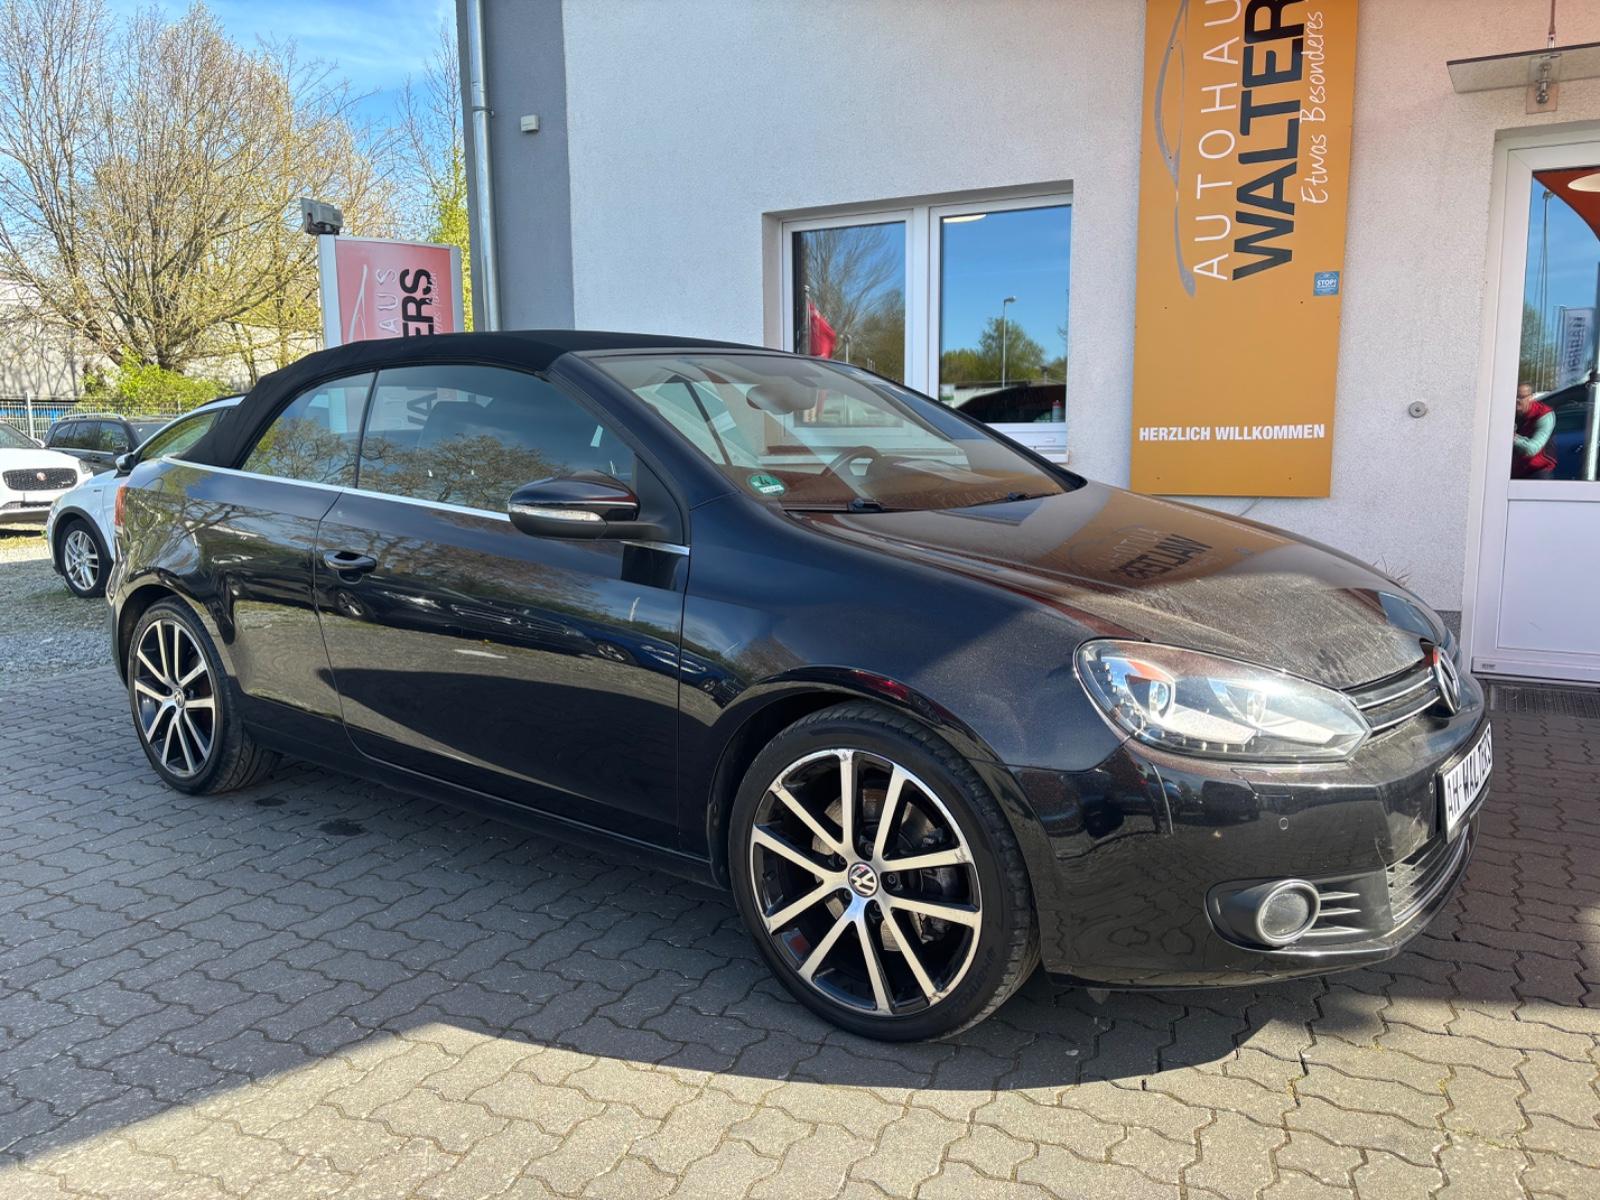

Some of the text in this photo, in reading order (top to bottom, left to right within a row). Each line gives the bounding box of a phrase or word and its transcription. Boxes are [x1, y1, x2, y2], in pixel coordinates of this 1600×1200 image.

[1232, 0, 1307, 281] WALTER
[1299, 11, 1329, 204] Etwas Besonderes
[376, 268, 399, 334] AUS
[1139, 424, 1325, 441] HERZLICH WILLKOMMEN
